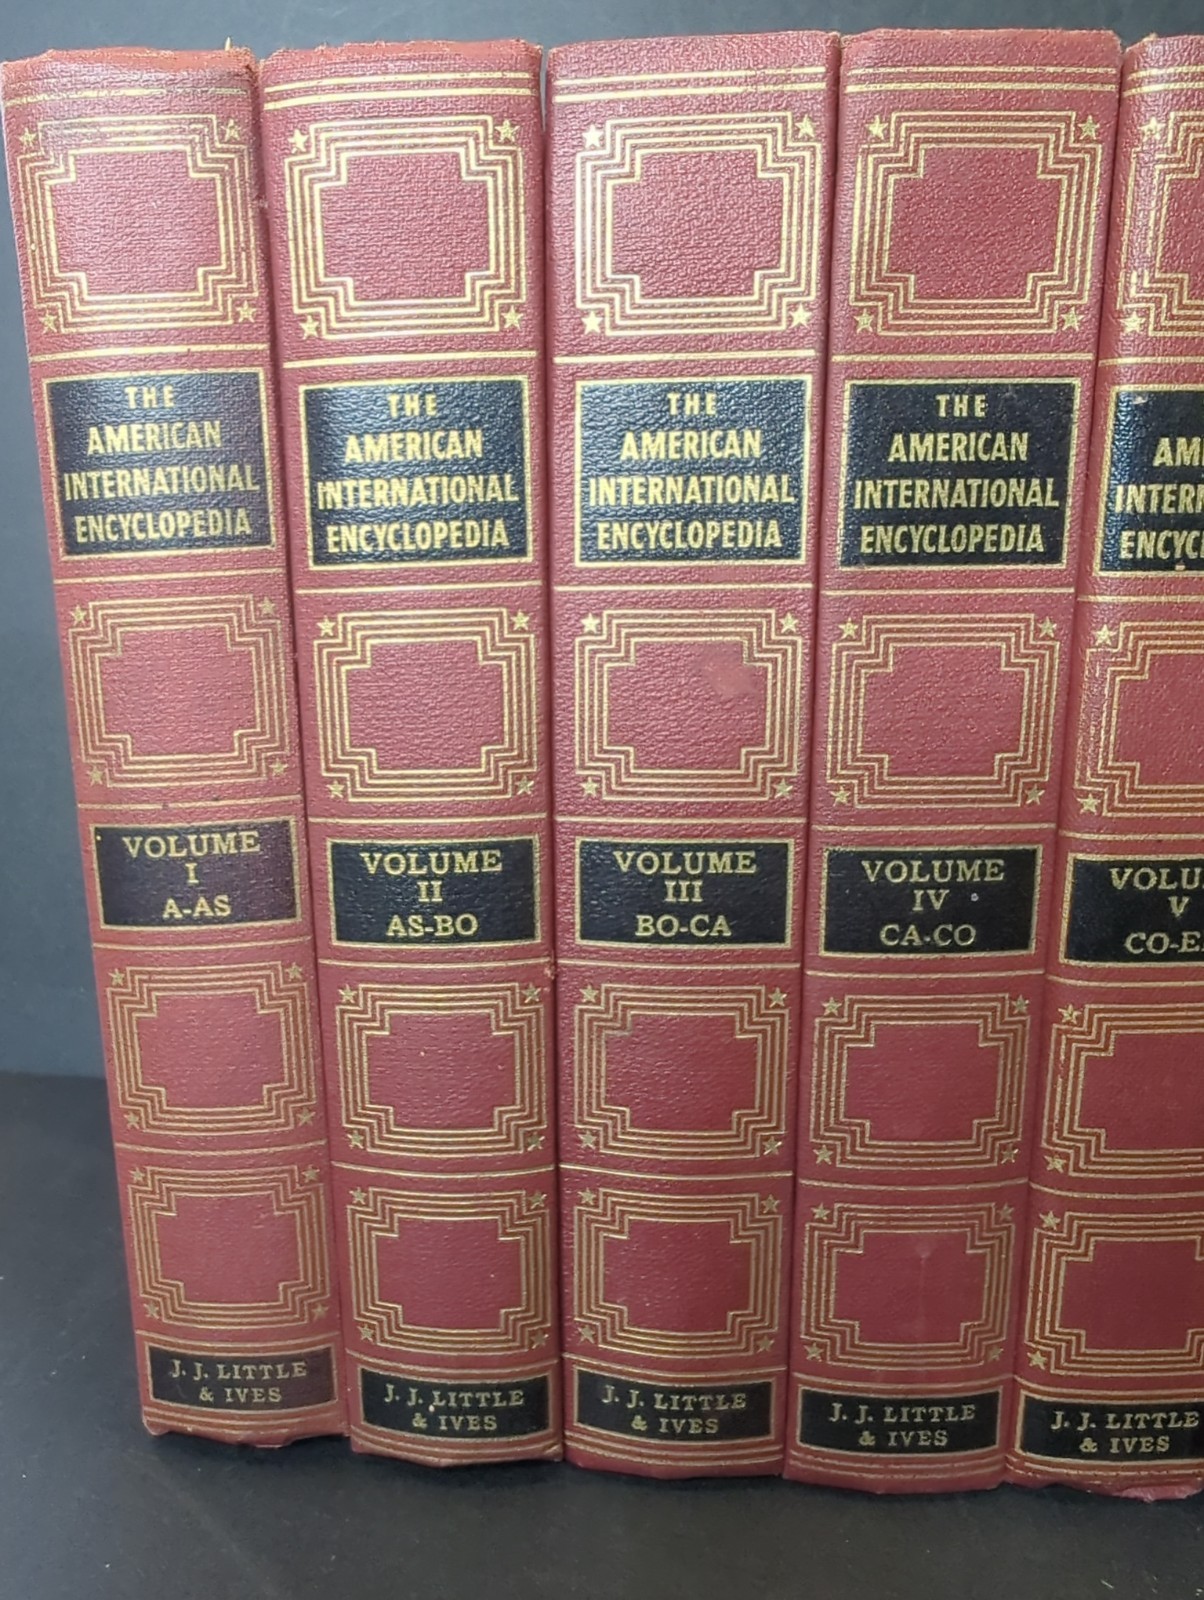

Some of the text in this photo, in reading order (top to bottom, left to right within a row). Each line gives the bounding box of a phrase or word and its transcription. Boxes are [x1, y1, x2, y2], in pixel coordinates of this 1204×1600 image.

[124, 385, 175, 409] THE
[386, 393, 437, 418] THE
[666, 392, 717, 418] THE
[936, 394, 986, 418] THE
[87, 420, 222, 455] AMERICAN
[344, 429, 485, 464] AMERICAN
[619, 429, 762, 463] AMERICAN
[887, 431, 1029, 463] AMERICAN
[1152, 436, 1204, 467] AM
[64, 464, 260, 501] INTERNATIONAL
[317, 473, 520, 511] INTERNATIONAL
[588, 474, 796, 509] INTERNATIONAL
[853, 477, 1060, 510] INTERNATIONAL
[74, 508, 252, 543] ENCYCLOPEDIA
[326, 518, 510, 553] ENCYCLOPEDIA
[596, 519, 783, 551] ENCYCLOPEDIA
[860, 523, 1045, 554] ENCYCLOPEDIA
[1119, 529, 1204, 560] ENCYC
[122, 829, 261, 858] VOLUME
[184, 862, 199, 884] I
[359, 850, 502, 876] VOLUME
[612, 850, 757, 875] VOLUME
[861, 859, 1005, 884] VOLUME
[416, 880, 443, 903] II
[664, 879, 703, 903] III
[1109, 867, 1204, 891] VOLU
[162, 894, 232, 919] A-AS
[912, 889, 950, 912] IV
[1168, 895, 1190, 918] V
[386, 913, 479, 938] AS-BO
[634, 914, 732, 937] BO-CA
[879, 923, 977, 947] CA-CO
[1124, 931, 1204, 955] CO-E
[171, 1359, 307, 1381] J. J. LITTLE
[199, 1386, 282, 1403] & IVES
[384, 1383, 524, 1408] J. J. LITTLE
[601, 1384, 746, 1411] J. J. LITTLE
[412, 1412, 497, 1431] & IVES
[631, 1415, 719, 1434] & IVES
[829, 1402, 976, 1425] J. J. LITTLE
[1050, 1411, 1199, 1432] J. J. LITTLE
[858, 1429, 948, 1447] & IVES
[1079, 1435, 1170, 1454] & IVES
